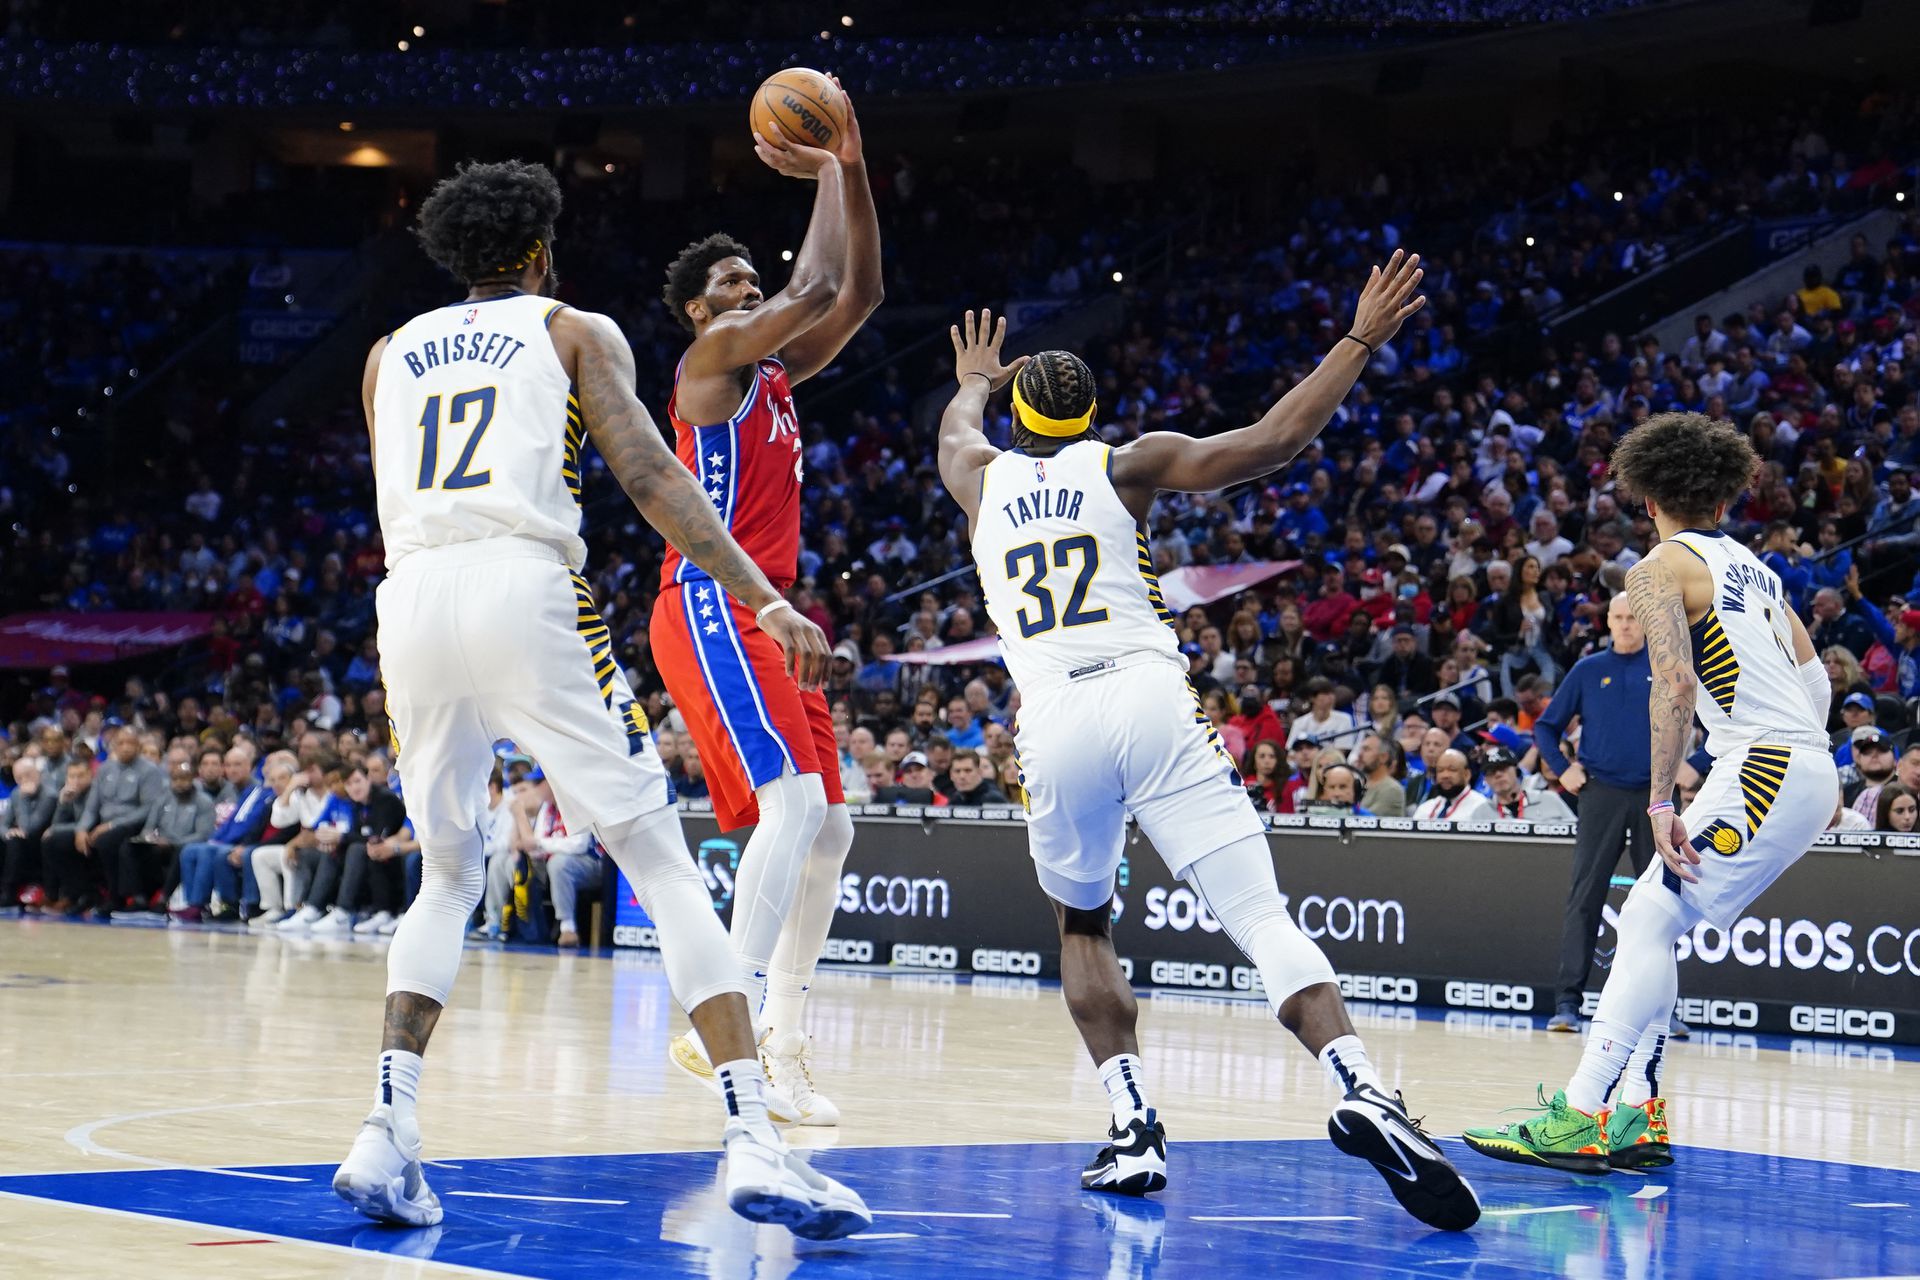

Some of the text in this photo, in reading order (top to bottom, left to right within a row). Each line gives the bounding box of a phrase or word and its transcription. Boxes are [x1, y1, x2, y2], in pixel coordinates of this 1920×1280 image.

[782, 94, 833, 145] Wilson
[403, 331, 526, 379] BRISSETT
[416, 385, 497, 491] 12
[1002, 488, 1085, 529] TAYLOR
[1005, 534, 1111, 640] 32
[1417, 821, 1451, 831] GEICO
[1456, 822, 1492, 833] GEICO
[1494, 823, 1529, 834] GEICO
[1533, 824, 1569, 835] GEICO
[1840, 834, 1881, 846] GEICO
[1886, 835, 1920, 847] GEIC
[891, 943, 958, 969] GEICO
[971, 948, 1041, 975] GEICO
[1151, 960, 1227, 988] GEICO
[1444, 981, 1534, 1011] GEICO
[1790, 1005, 1895, 1038] GEICO
